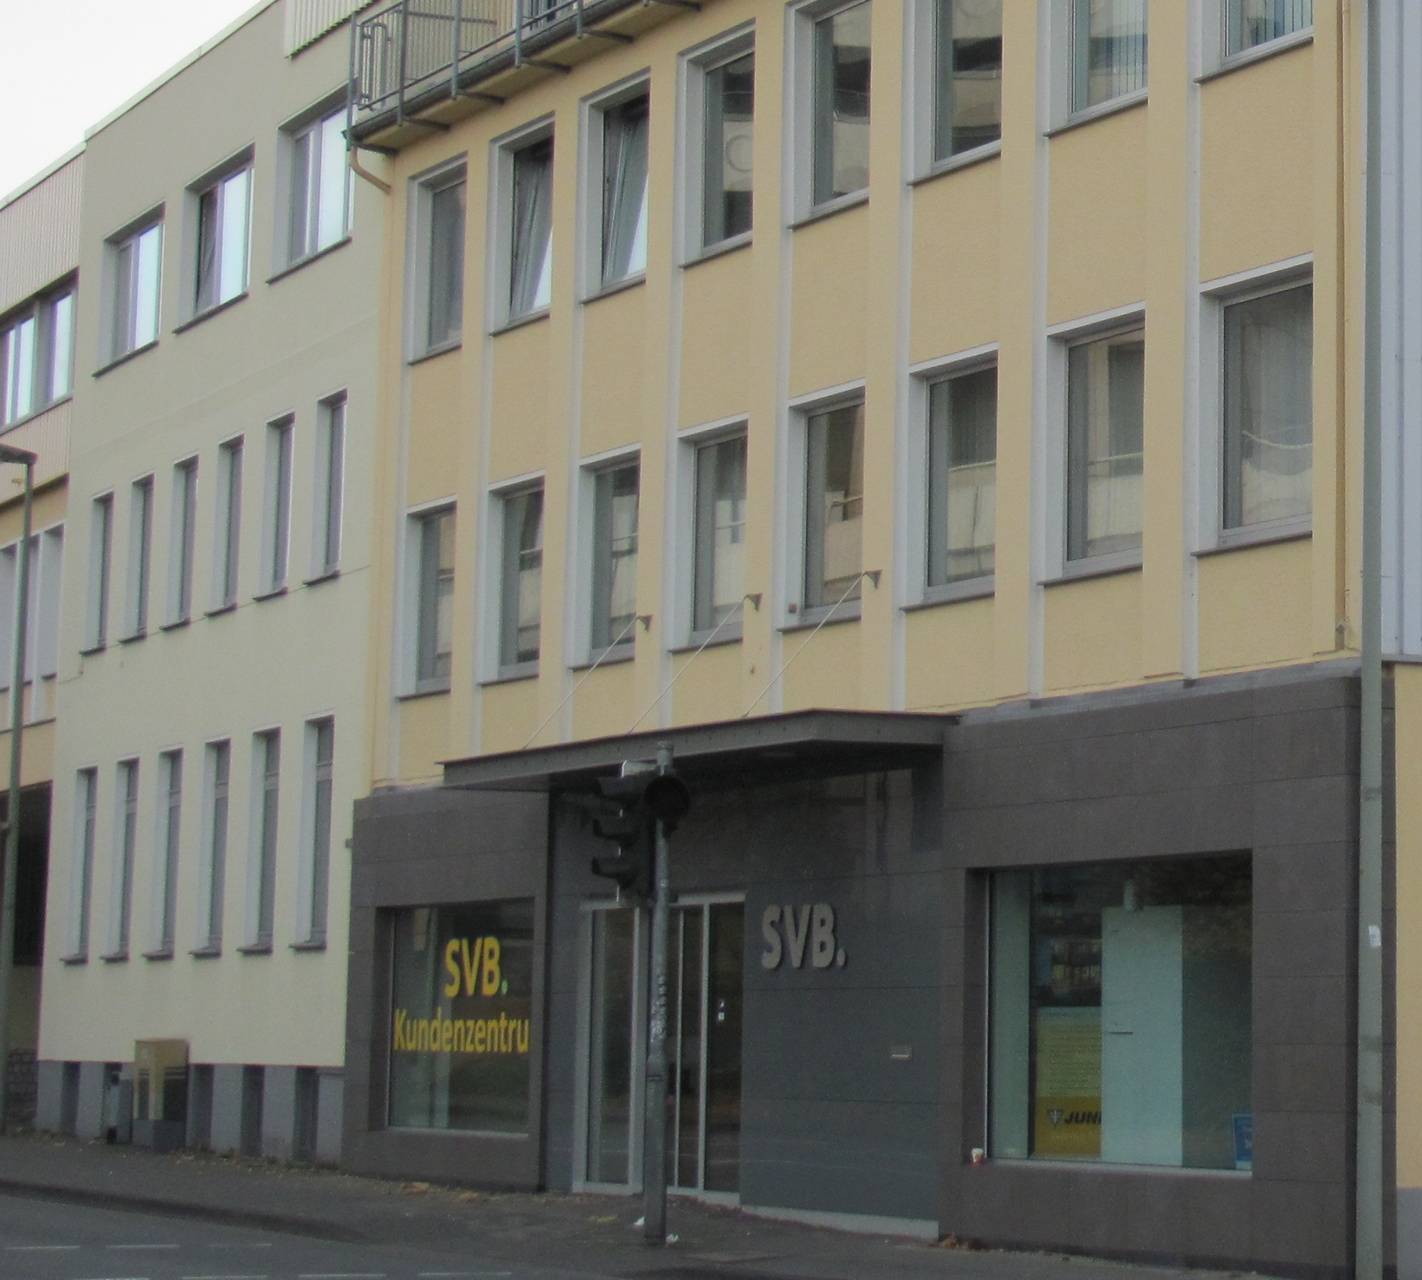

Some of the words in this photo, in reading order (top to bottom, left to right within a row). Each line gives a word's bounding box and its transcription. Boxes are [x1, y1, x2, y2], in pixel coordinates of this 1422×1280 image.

[443, 935, 509, 999] SVB.
[761, 903, 847, 970] SVB.
[393, 1006, 530, 1054] Kundenzentru
